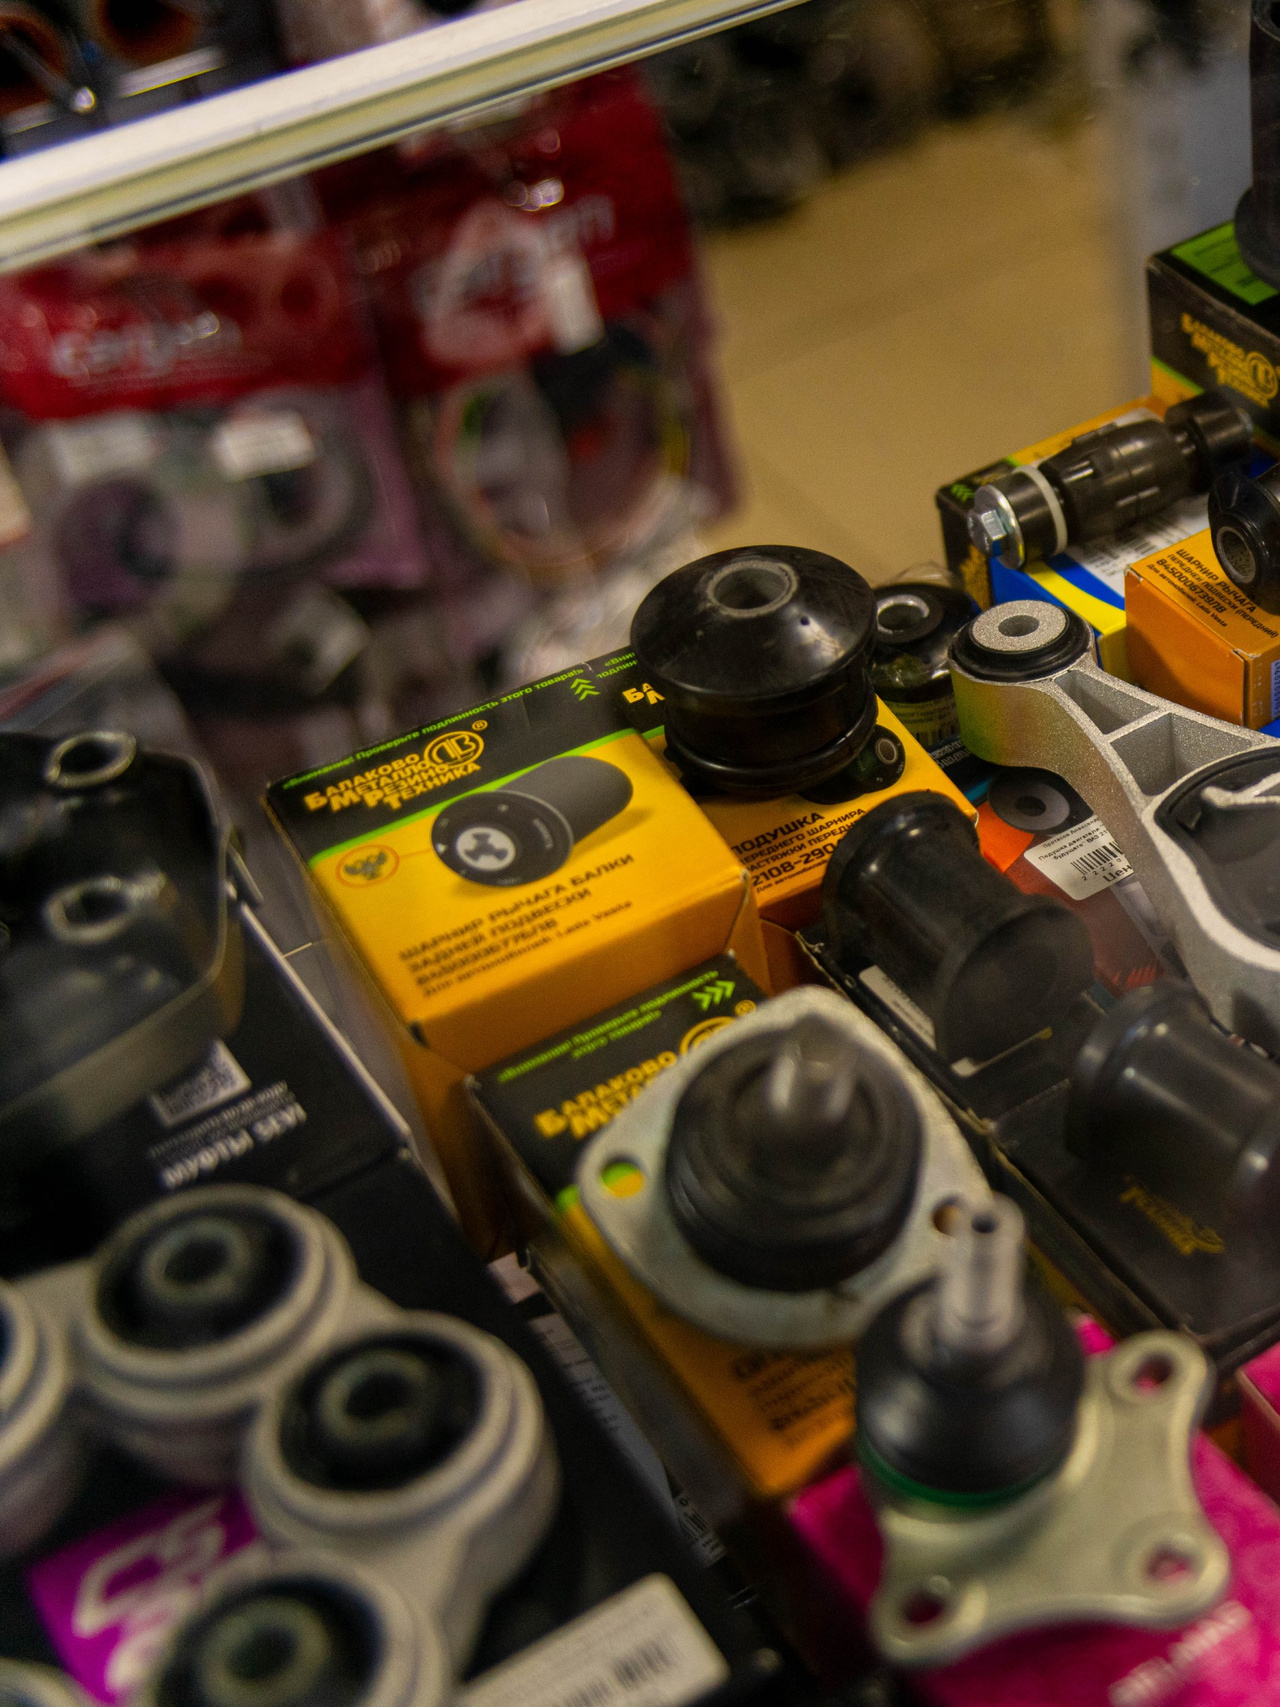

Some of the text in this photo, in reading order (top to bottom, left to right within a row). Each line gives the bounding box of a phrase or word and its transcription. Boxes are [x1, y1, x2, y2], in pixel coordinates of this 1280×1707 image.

[1176, 547, 1257, 614] ШАРНИР РЫЧАГА
[501, 685, 533, 704] этого
[304, 753, 420, 811] БАЛАКОВО
[383, 762, 482, 810] ТЕХНИКА
[740, 808, 867, 866] ЕРЕДНЕГО ШАРНИРА
[749, 842, 807, 873] АСТЯЖКИ
[569, 853, 635, 887] БАЛКИ
[752, 842, 838, 887] 2108-290
[1102, 864, 1133, 883] Цен
